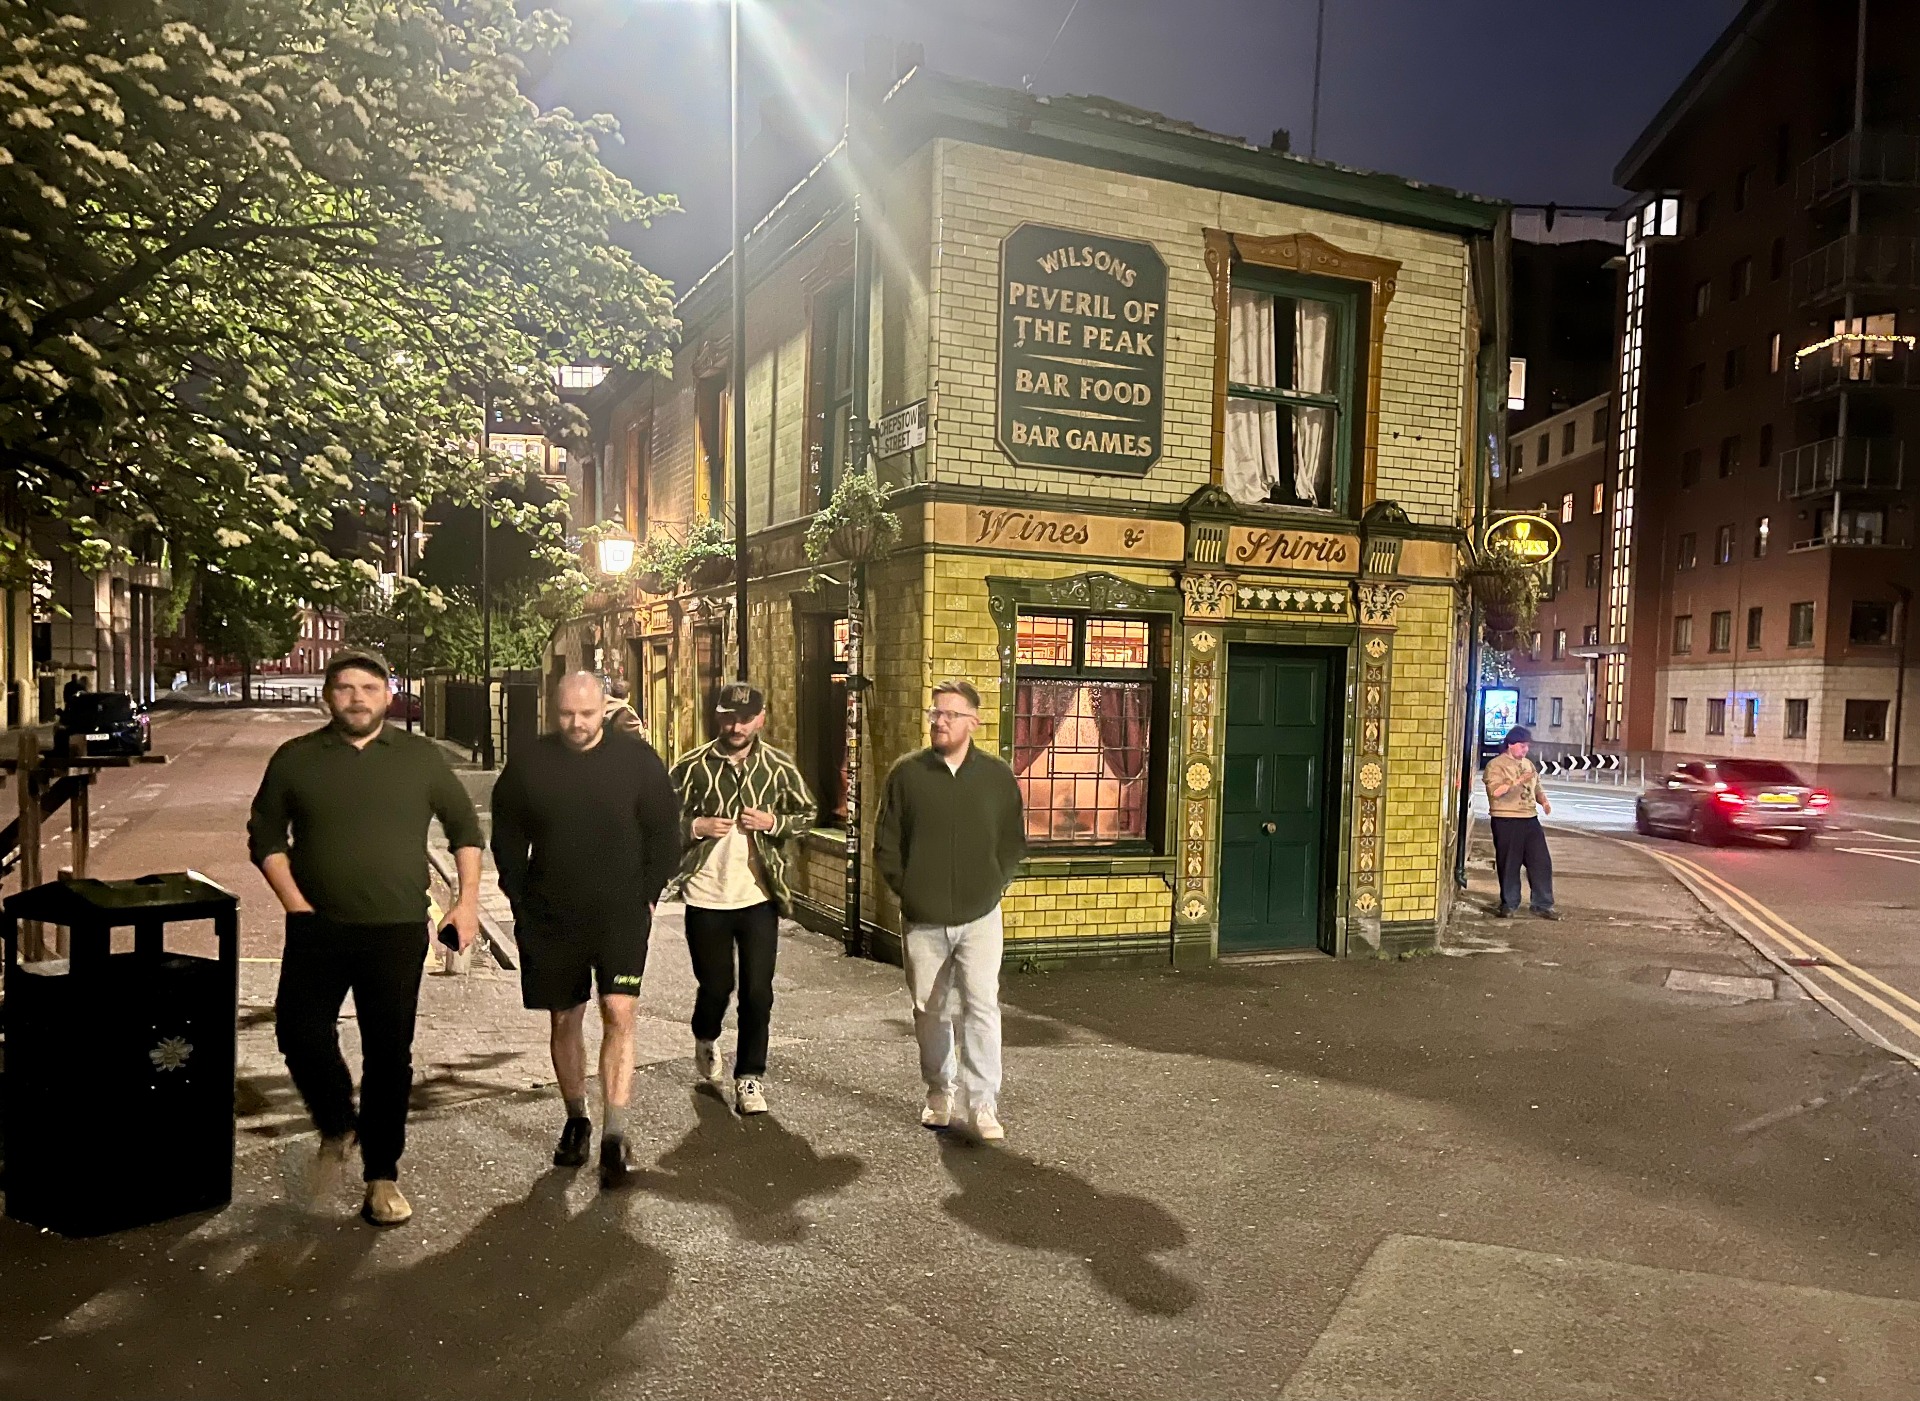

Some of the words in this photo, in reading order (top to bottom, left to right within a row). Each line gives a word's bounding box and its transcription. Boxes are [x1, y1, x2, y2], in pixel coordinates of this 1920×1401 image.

[1037, 246, 1137, 288] WILSONS
[1009, 281, 1116, 320] PEVERIL
[1123, 300, 1159, 325] OF
[1013, 315, 1072, 348] THE
[1083, 325, 1155, 357] PEAK
[1015, 368, 1071, 398] BAR
[1080, 377, 1151, 407] FOOD
[880, 407, 918, 437] CHEPSTOW
[884, 430, 911, 454] STREET
[1012, 419, 1060, 449] BAR
[1065, 428, 1152, 457] GAMES
[975, 509, 1089, 545] Wines
[1123, 527, 1145, 549] &
[1235, 530, 1347, 564] Spirits
